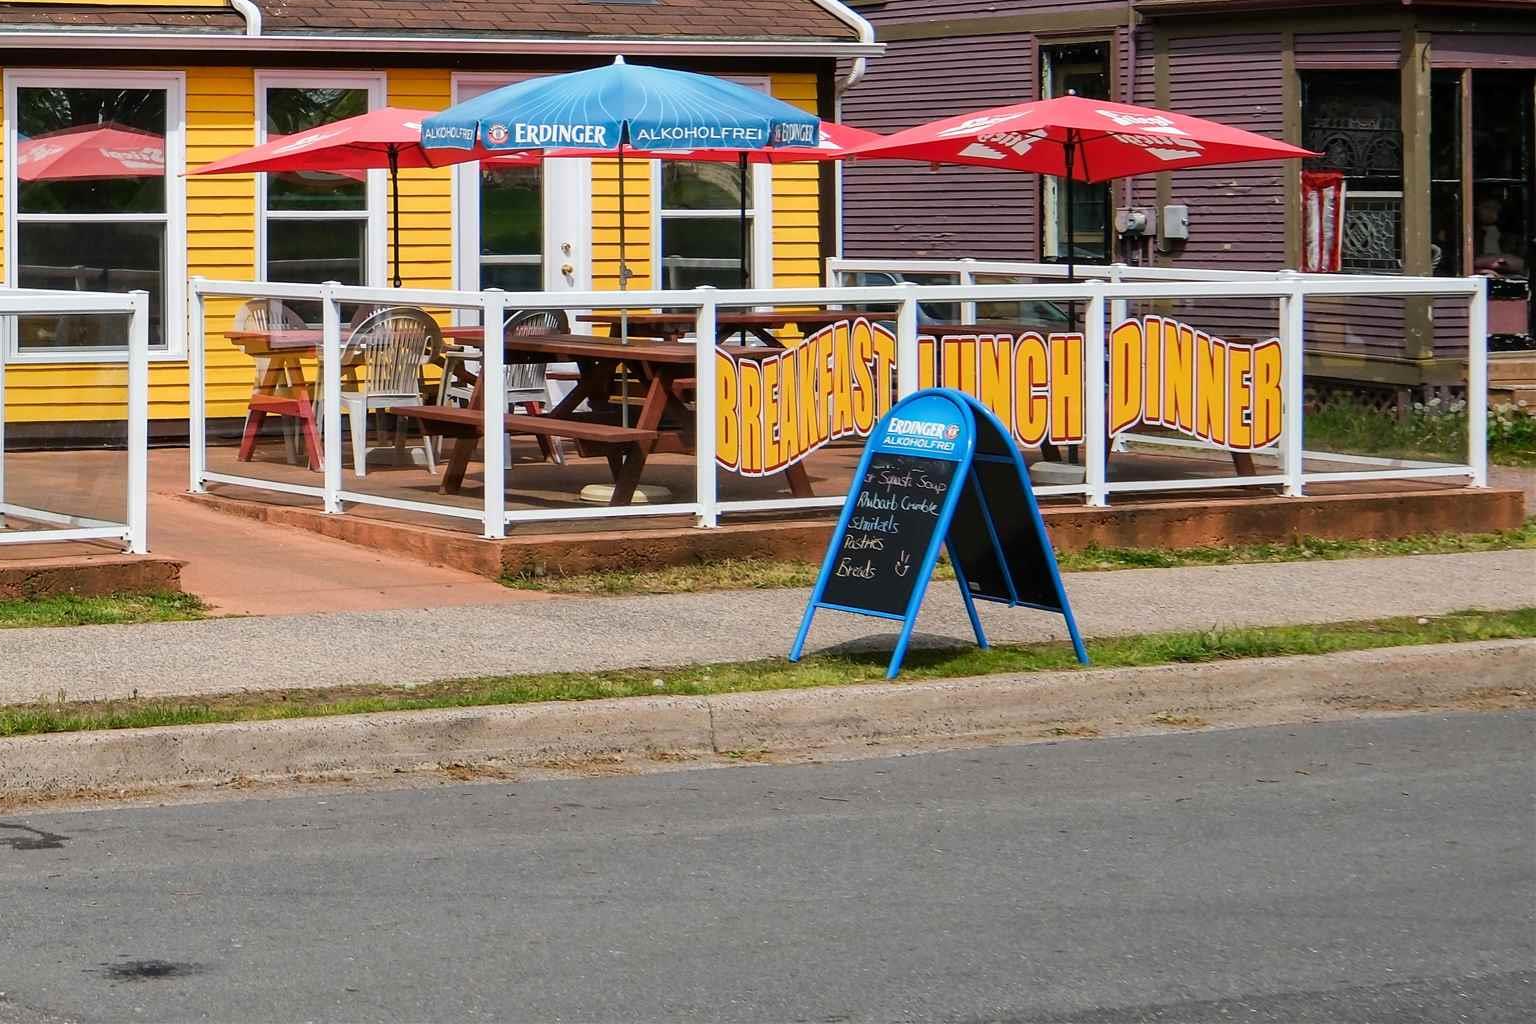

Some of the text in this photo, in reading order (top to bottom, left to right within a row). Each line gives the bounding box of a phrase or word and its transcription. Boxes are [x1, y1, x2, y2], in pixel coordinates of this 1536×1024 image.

[515, 123, 608, 146] ERDINGER
[637, 126, 763, 141] ALKOHOLFREI
[715, 317, 897, 476] BREAKFAST
[1108, 315, 1283, 452] DINNER
[887, 417, 945, 439] ERDINGER
[883, 436, 956, 452] ALKOHOLFREI
[915, 474, 948, 494] Soup
[857, 491, 898, 511] Rhubarb
[843, 534, 885, 551] Pastries
[835, 557, 878, 580] Breads
